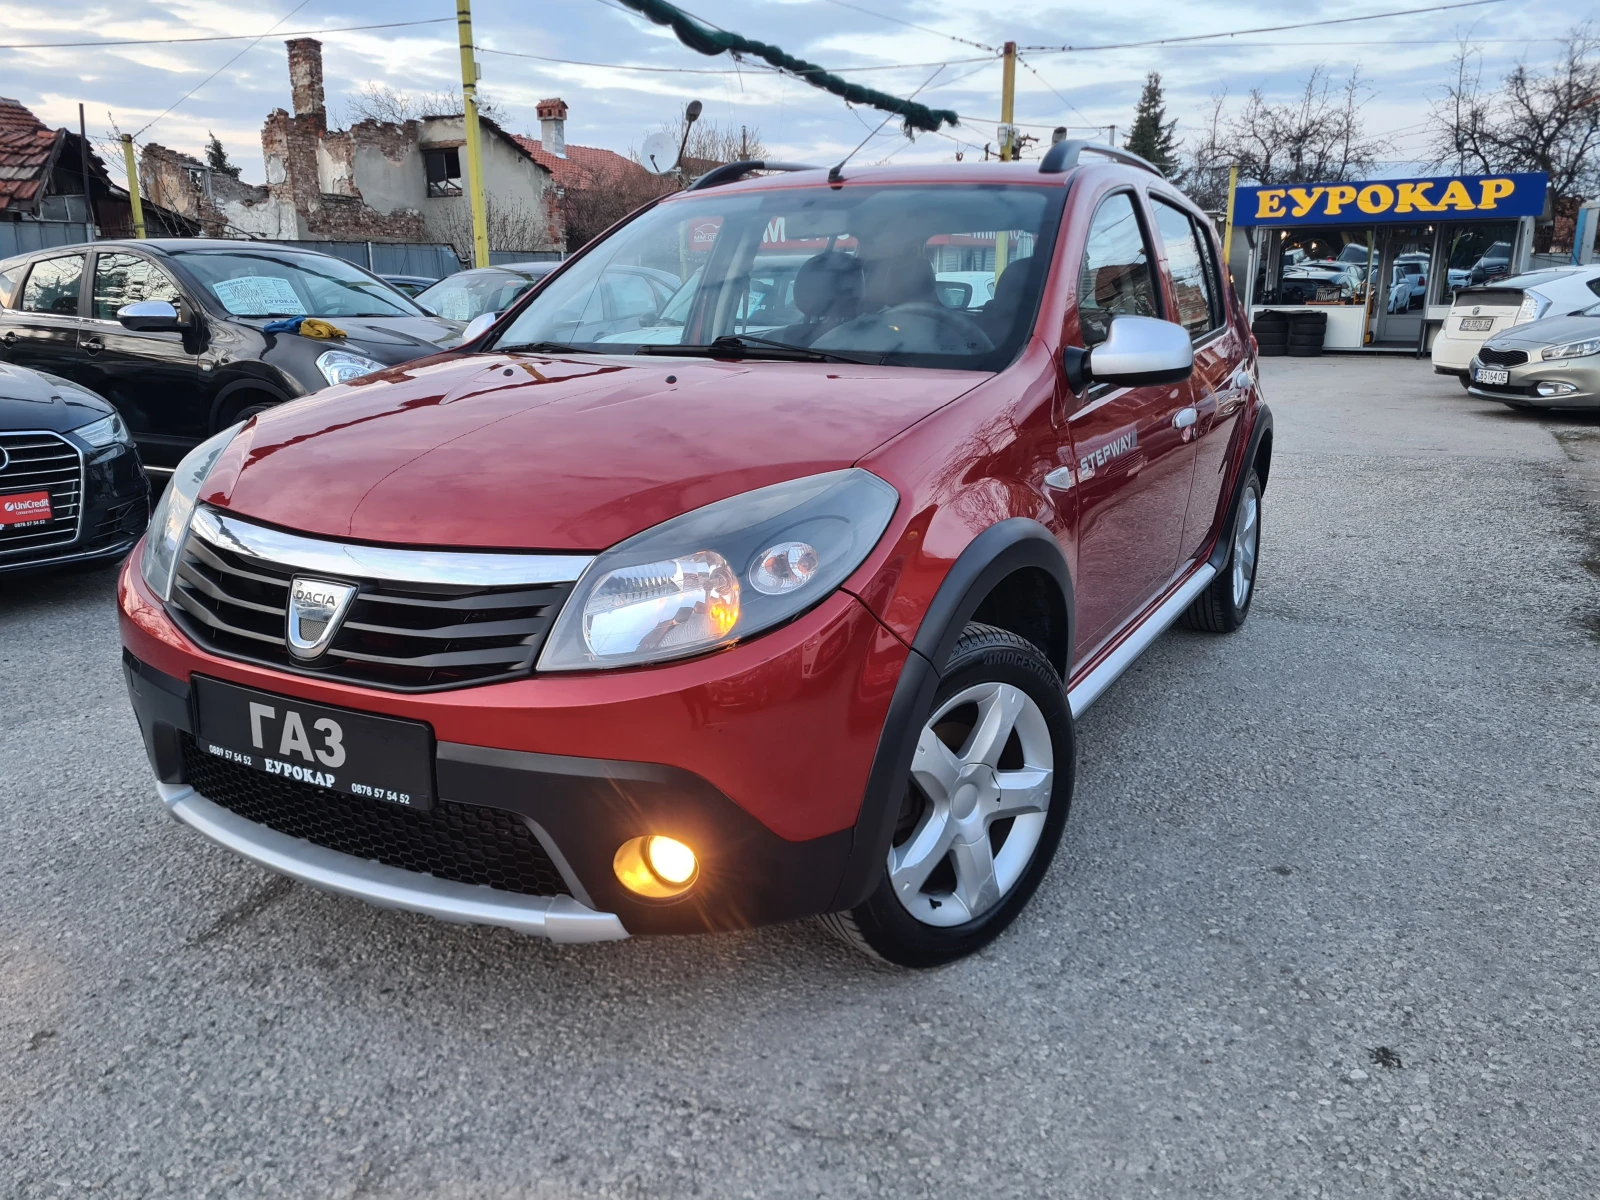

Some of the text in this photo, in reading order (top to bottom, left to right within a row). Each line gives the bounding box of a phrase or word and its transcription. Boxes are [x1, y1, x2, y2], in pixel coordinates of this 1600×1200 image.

[1255, 178, 1515, 218] ЕУРОКАР
[1081, 432, 1131, 476] STEPWAY
[14, 499, 50, 510] UniCredit
[296, 589, 336, 607] DACIA
[249, 701, 346, 768] ГАЗ
[208, 744, 252, 766] 0889 57 54 52
[264, 758, 336, 788] ЕУРОКАР
[351, 782, 411, 805] 0878 57 54 52
